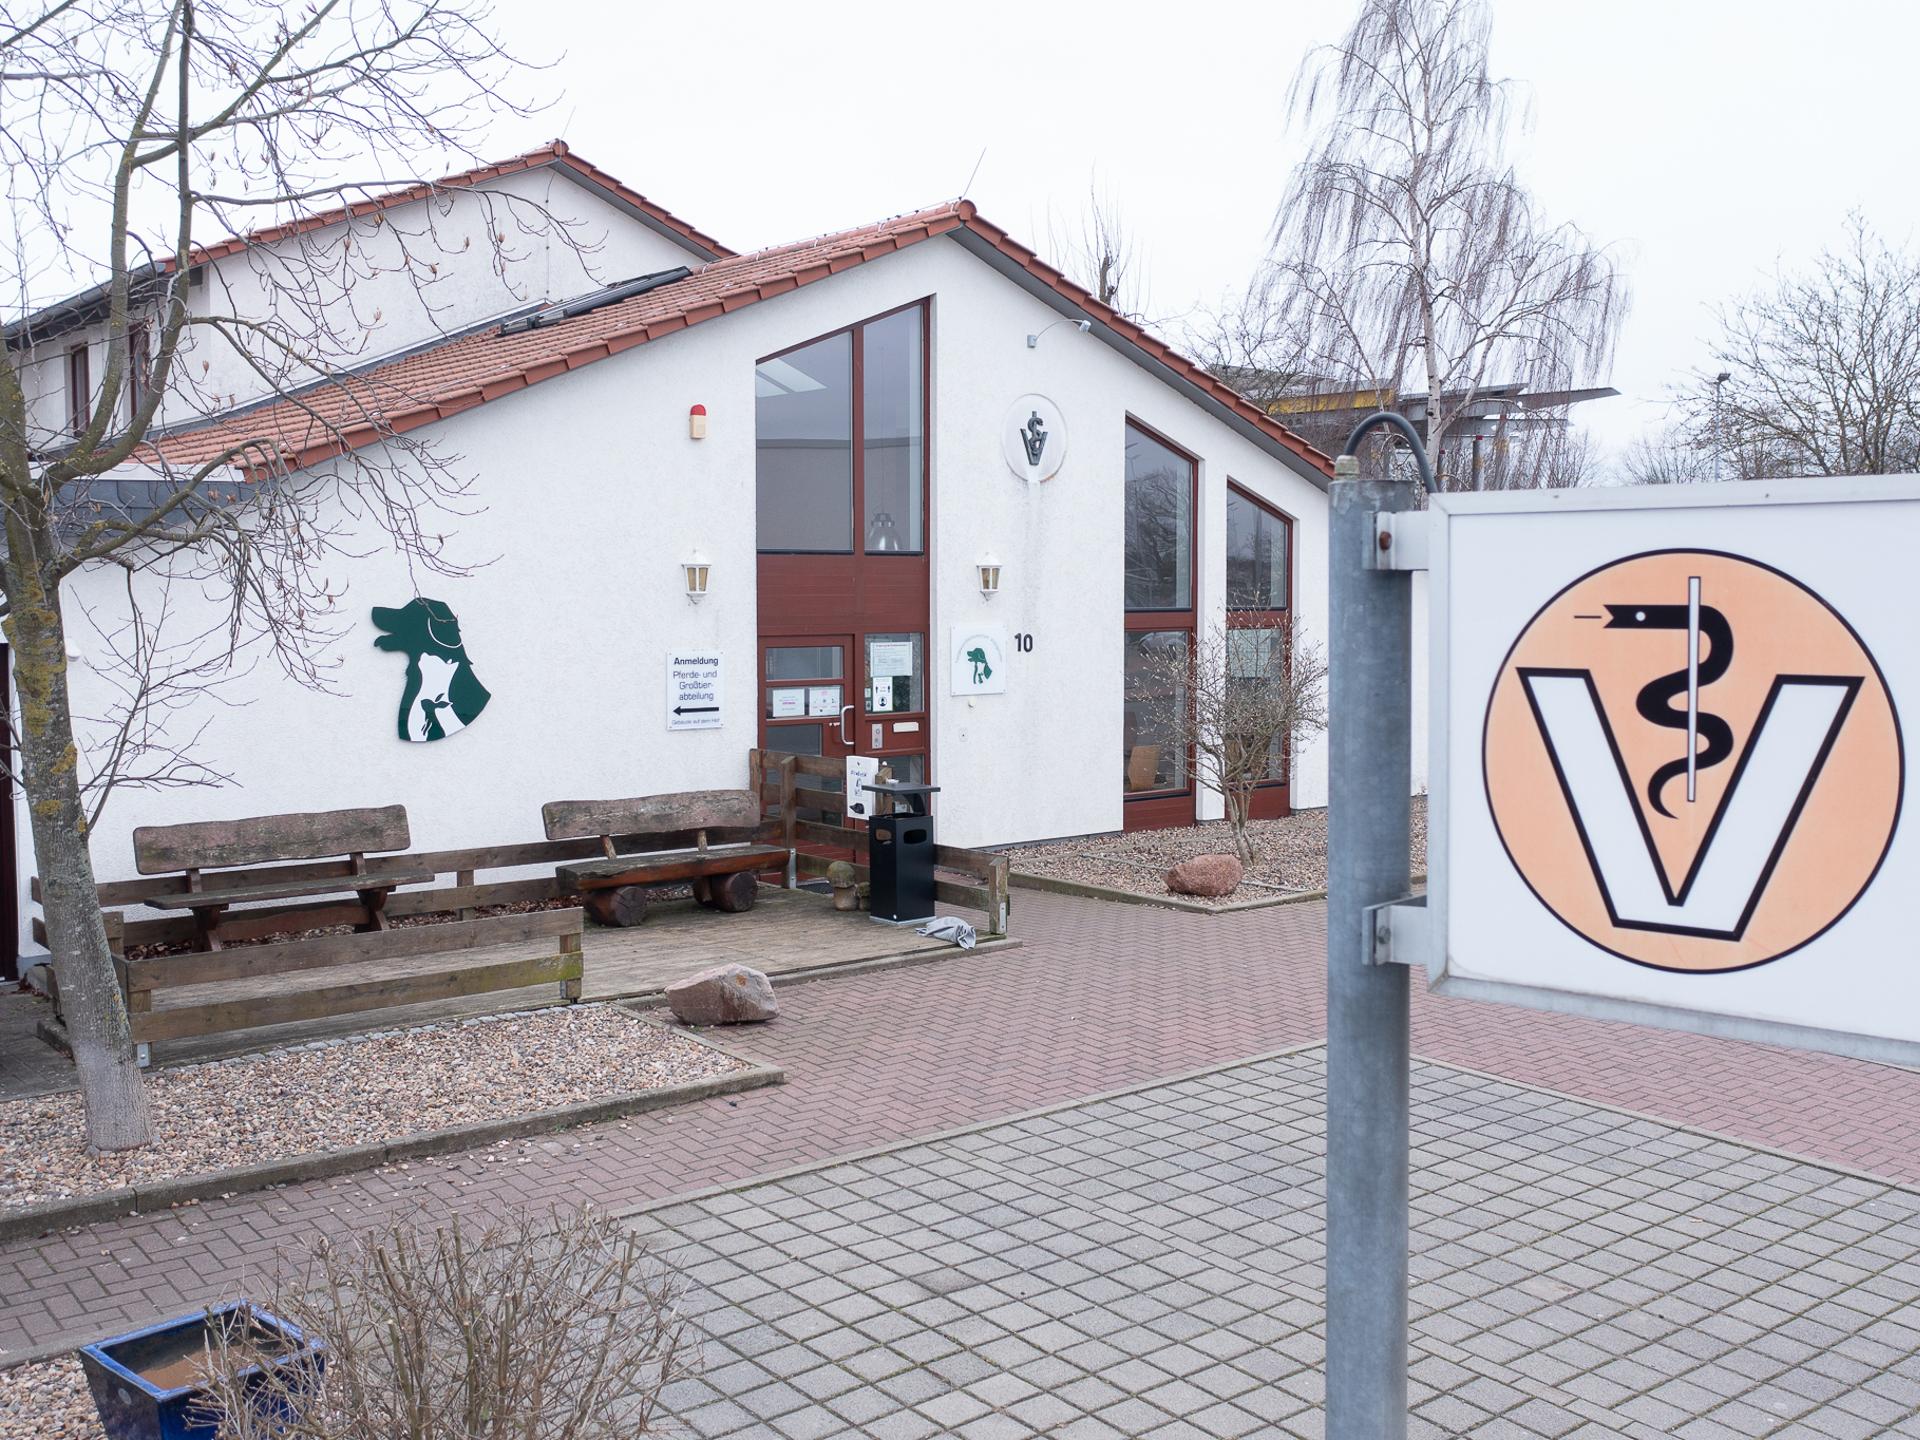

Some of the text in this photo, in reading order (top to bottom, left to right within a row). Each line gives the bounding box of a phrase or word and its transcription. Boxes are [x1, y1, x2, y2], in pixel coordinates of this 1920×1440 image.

[1014, 633, 1033, 653] 10
[674, 657, 718, 666] Anmeldung
[673, 670, 717, 679] Pferde- und
[679, 692, 713, 701] abteilung
